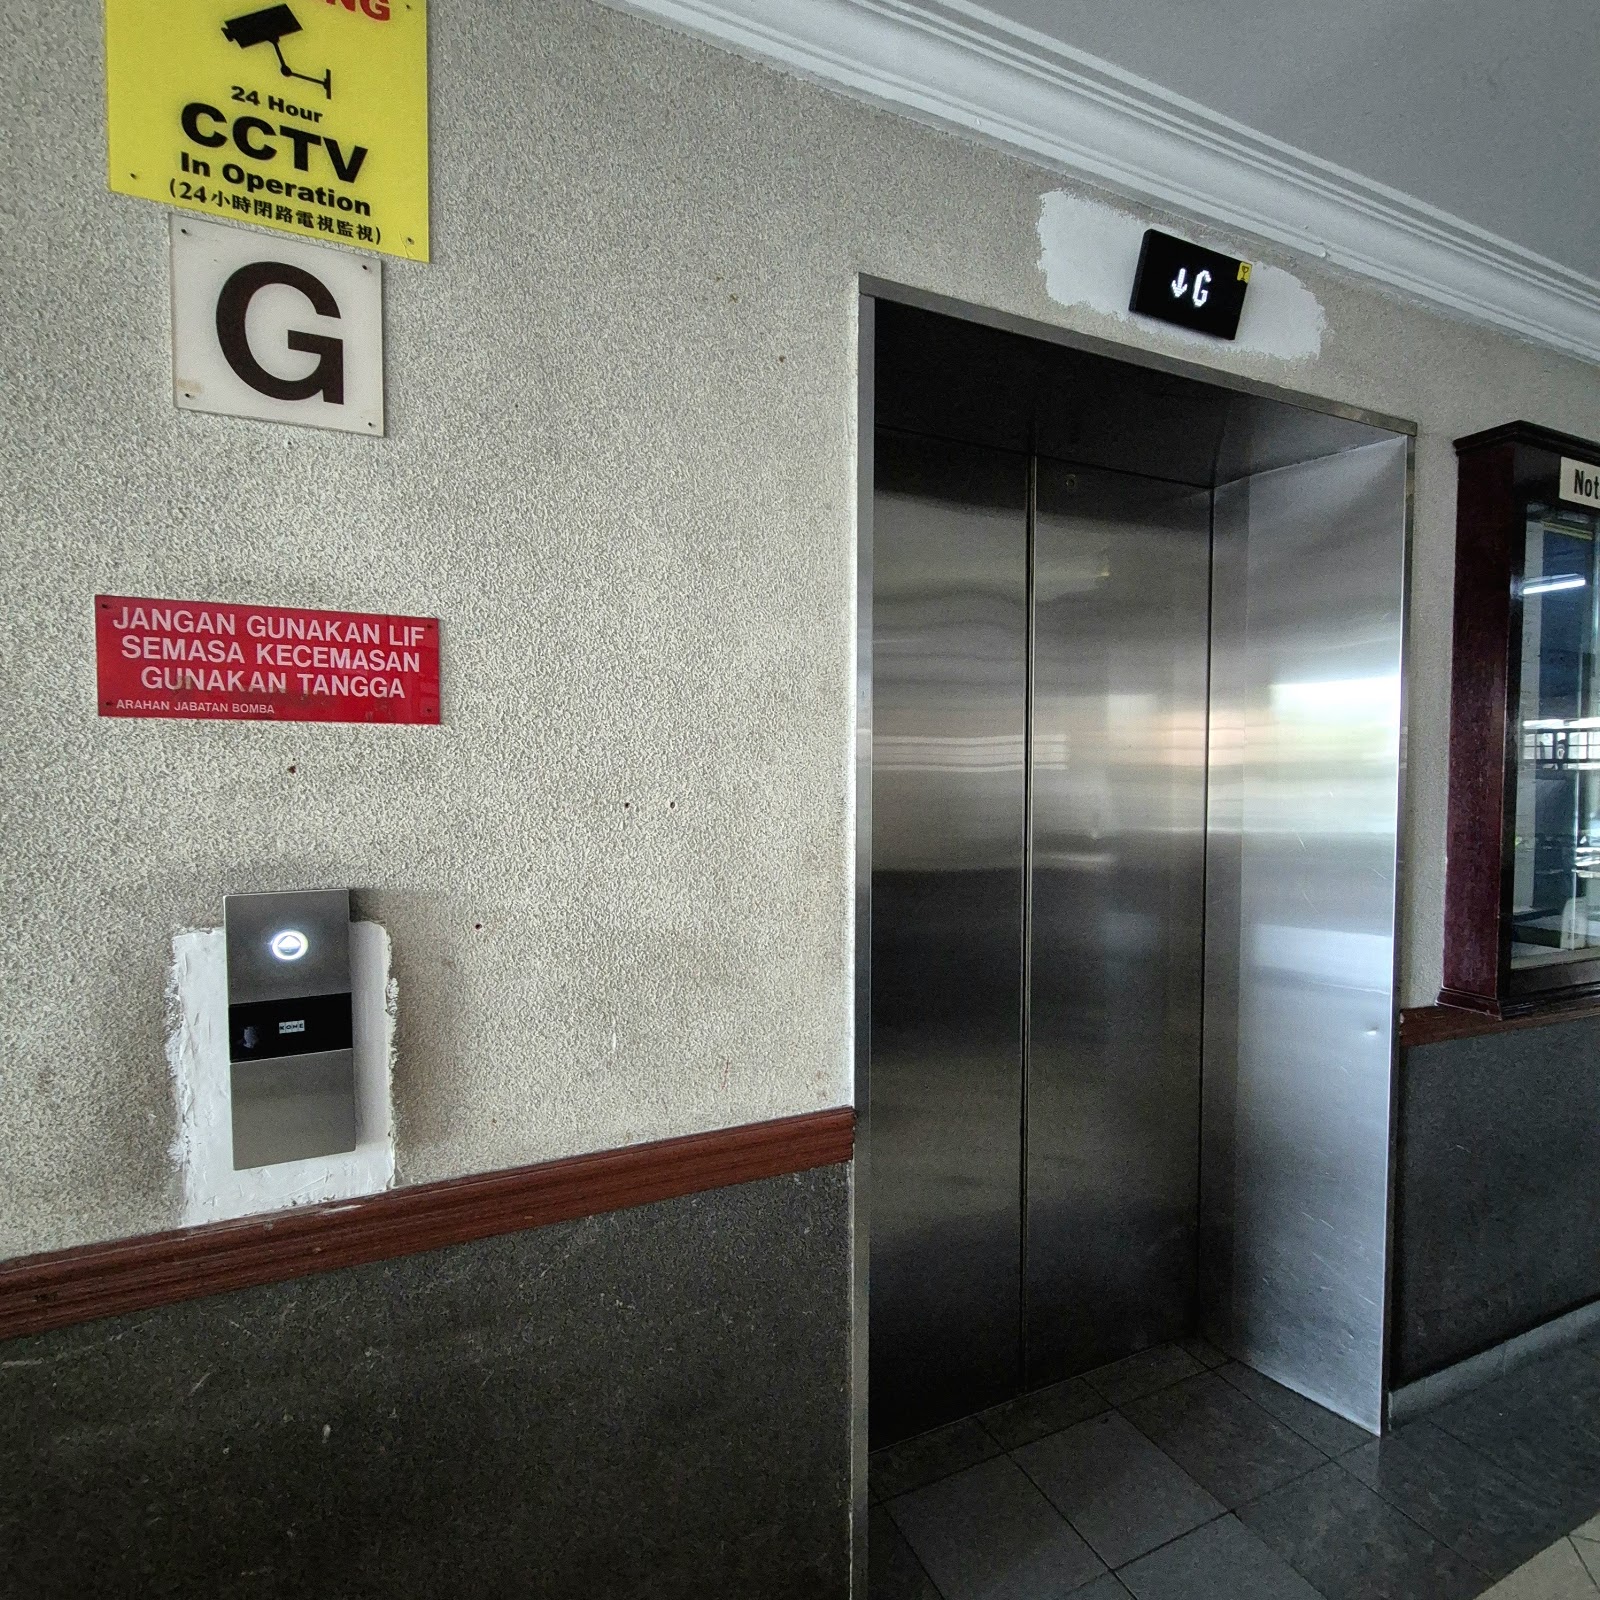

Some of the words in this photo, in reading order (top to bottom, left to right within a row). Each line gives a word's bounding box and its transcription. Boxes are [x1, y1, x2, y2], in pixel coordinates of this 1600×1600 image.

[230, 86, 260, 106] 24
[268, 95, 323, 123] Hour
[181, 102, 368, 183] CCTV
[180, 152, 211, 177] In
[222, 163, 371, 216] Operation
[1192, 269, 1212, 308] G
[216, 261, 344, 405] G
[112, 606, 236, 636] JANGAN
[246, 615, 380, 645] GUNAKAN
[388, 625, 425, 647] LIF
[121, 634, 245, 664] SEMASA
[256, 643, 420, 673] KECEMASAN
[141, 666, 286, 694] GUNAKAN
[297, 673, 406, 699] TANGGA
[116, 699, 170, 711] ARAHAN
[174, 701, 229, 713] JABATAN
[232, 703, 275, 714] BOMBA
